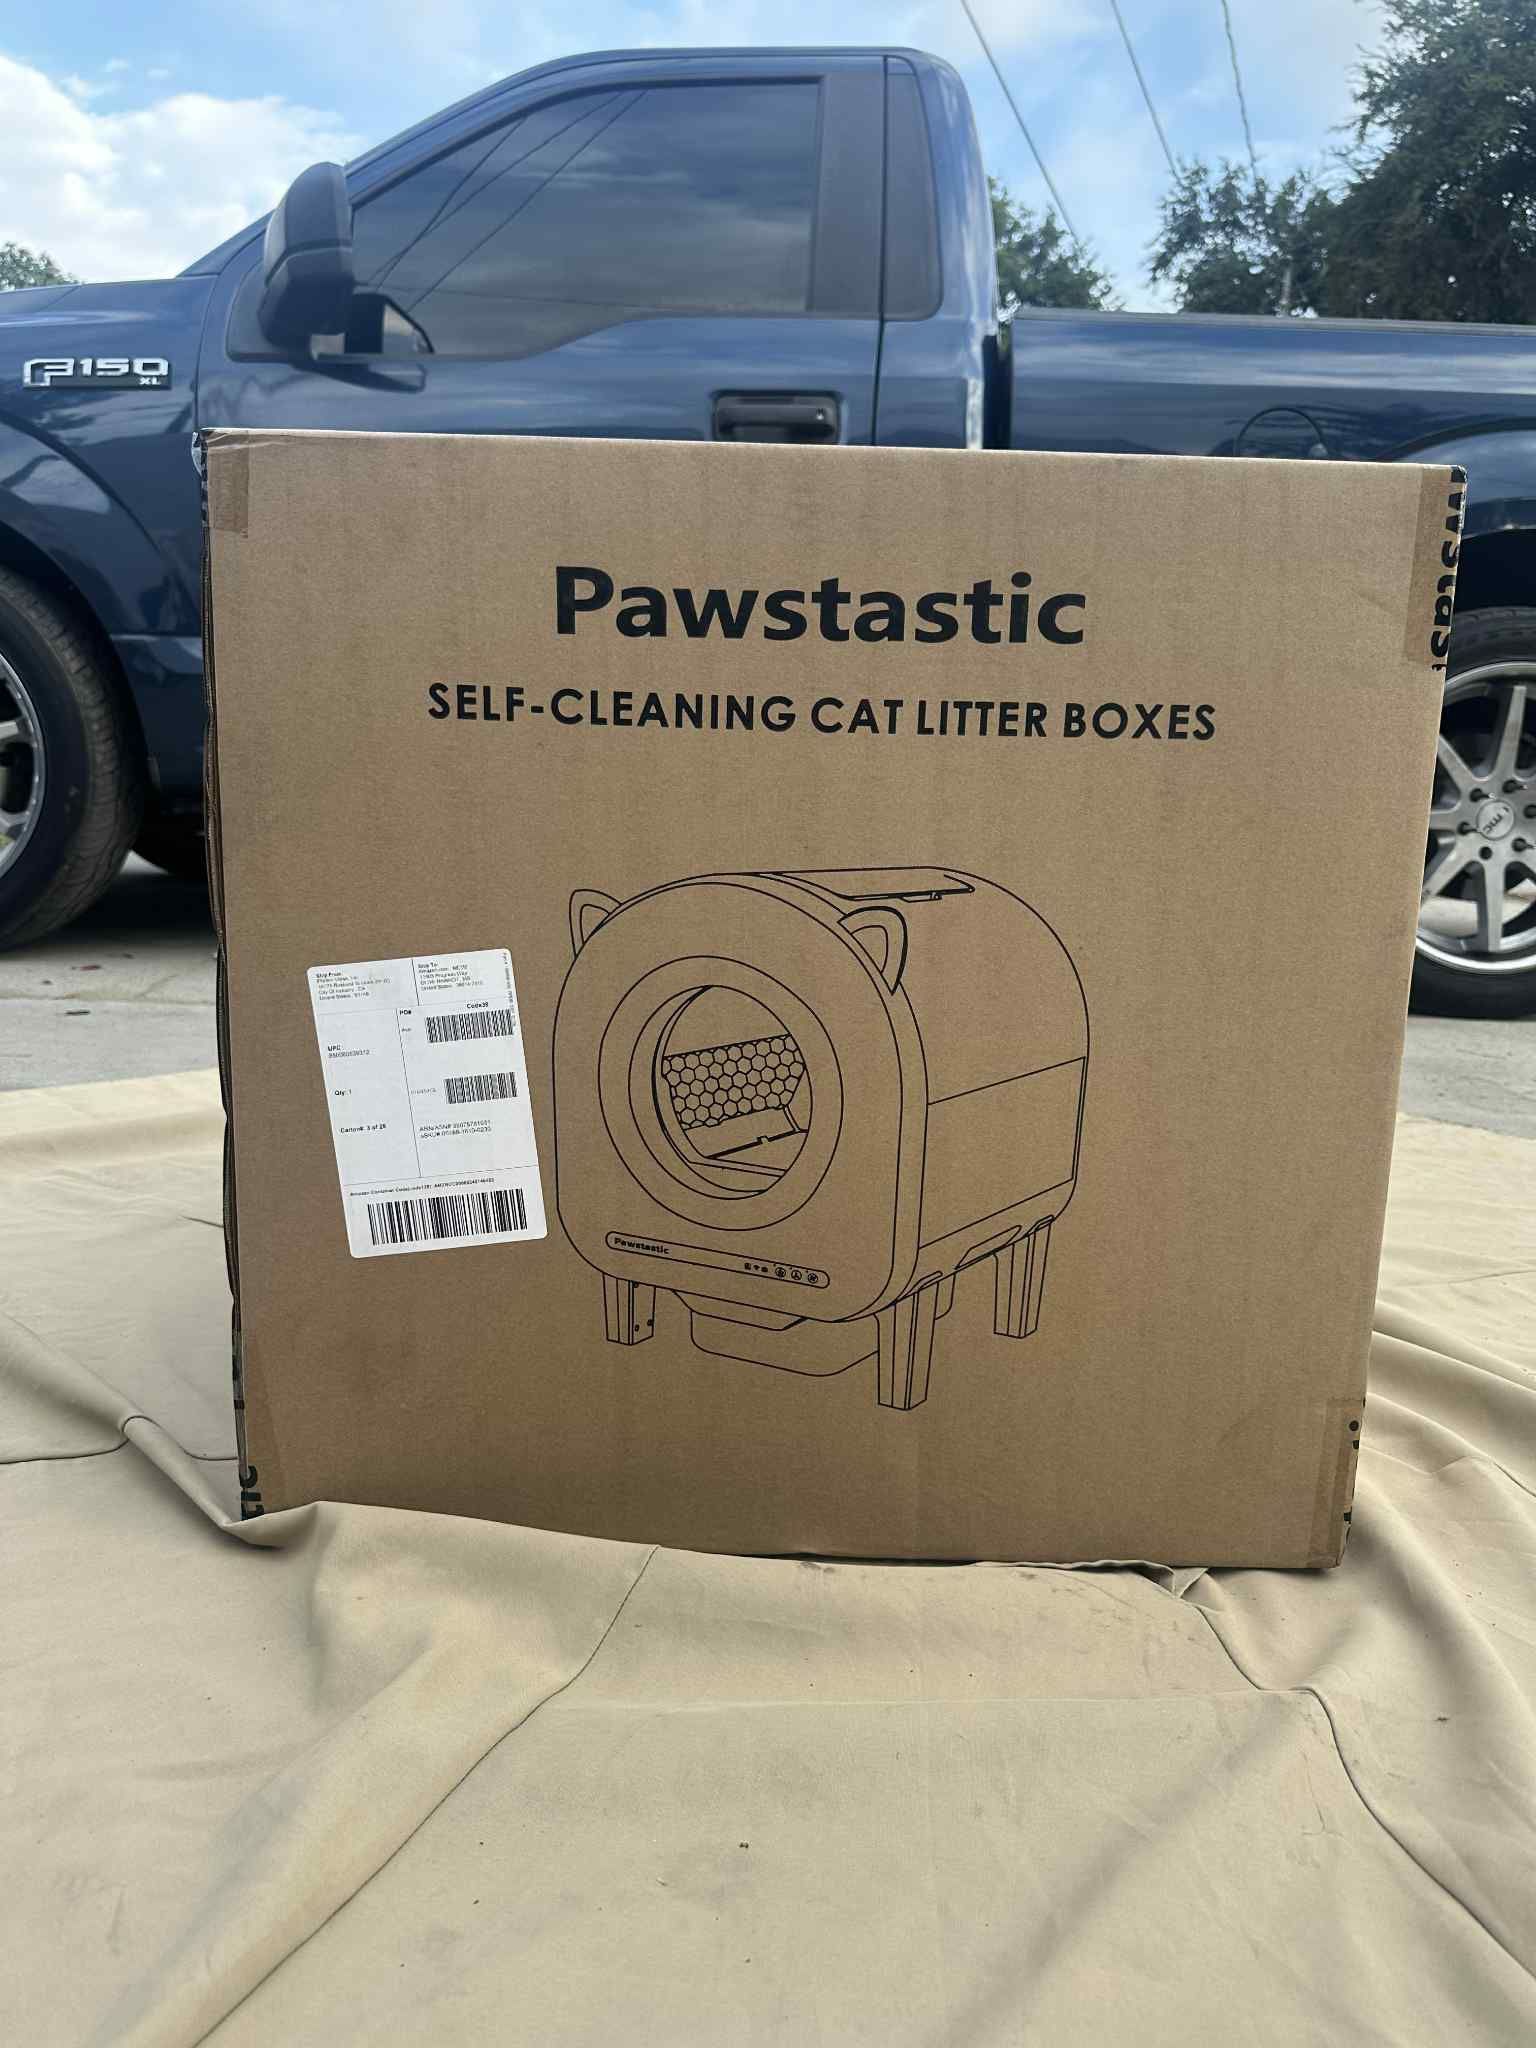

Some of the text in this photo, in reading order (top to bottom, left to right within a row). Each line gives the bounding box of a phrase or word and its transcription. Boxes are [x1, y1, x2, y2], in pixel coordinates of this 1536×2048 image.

[139, 377, 161, 386] XL
[556, 566, 1086, 645] Pawstastic
[428, 683, 1216, 741] SELF-CLEANING CAT LITTER BOXES
[614, 1237, 669, 1254] Pawstastic
